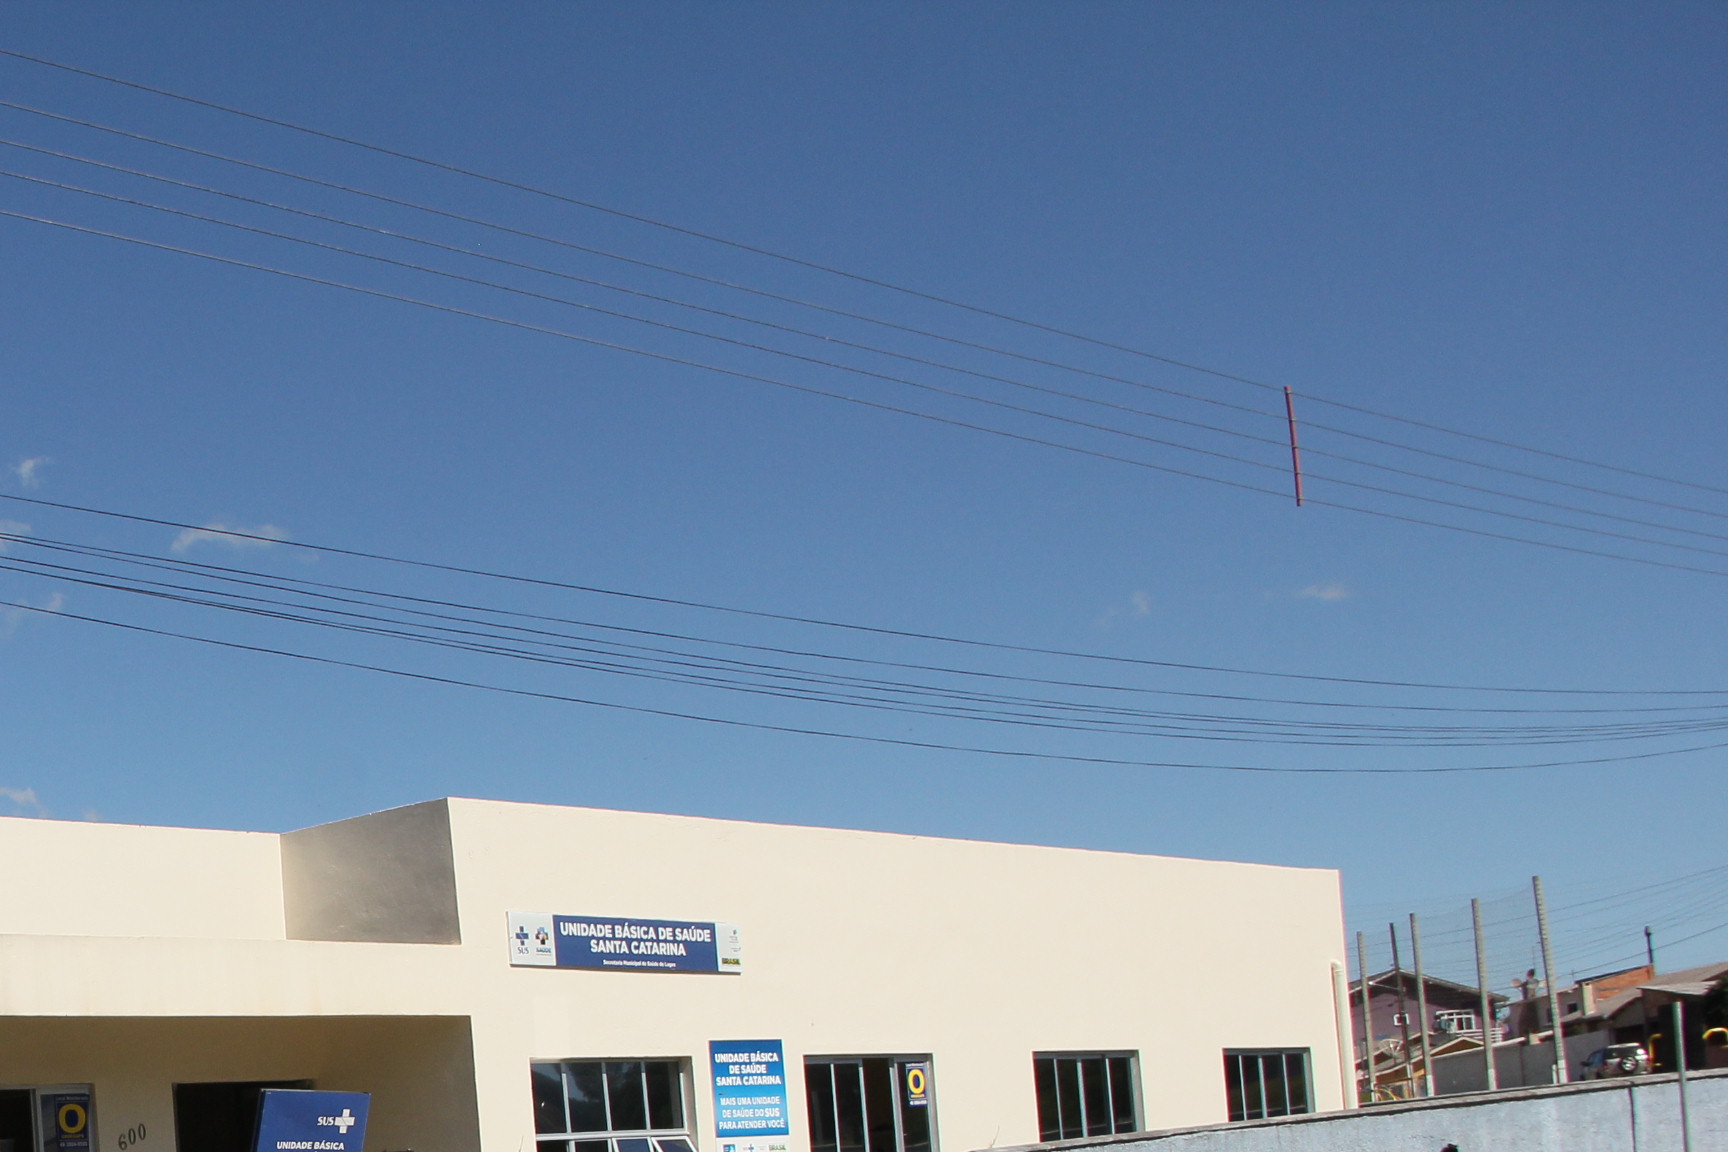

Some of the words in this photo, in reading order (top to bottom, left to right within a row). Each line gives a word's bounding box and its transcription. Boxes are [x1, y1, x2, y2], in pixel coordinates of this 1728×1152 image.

[560, 922, 613, 938] UNIDADE
[614, 923, 655, 940] BÁSICA
[658, 927, 674, 941] DE
[675, 925, 711, 942] SAÚDE
[517, 946, 529, 954] SUS
[590, 940, 628, 954] SANTA
[630, 941, 686, 956] CATARINA
[715, 1053, 749, 1063] UNIDADE
[750, 1051, 779, 1062] BÁSICA
[729, 1065, 740, 1074] DE
[741, 1063, 767, 1073] SAÚDE
[716, 1076, 742, 1086] SANTA
[743, 1075, 781, 1085] CATARINA
[720, 1097, 736, 1106] MAIS
[737, 1097, 752, 1105] UMA
[752, 1096, 780, 1105] UNIDADE
[722, 1109, 732, 1118] DE
[733, 1107, 754, 1117] SAÚDE
[754, 1108, 764, 1117] DO
[765, 1108, 780, 1117] SUS
[317, 1116, 334, 1126] SUS
[719, 1121, 738, 1130] PARA
[738, 1120, 767, 1129] ATENDER
[118, 1123, 147, 1151] 600
[276, 1141, 313, 1150] UNIDADE
[313, 1140, 345, 1150] BÁSICA
